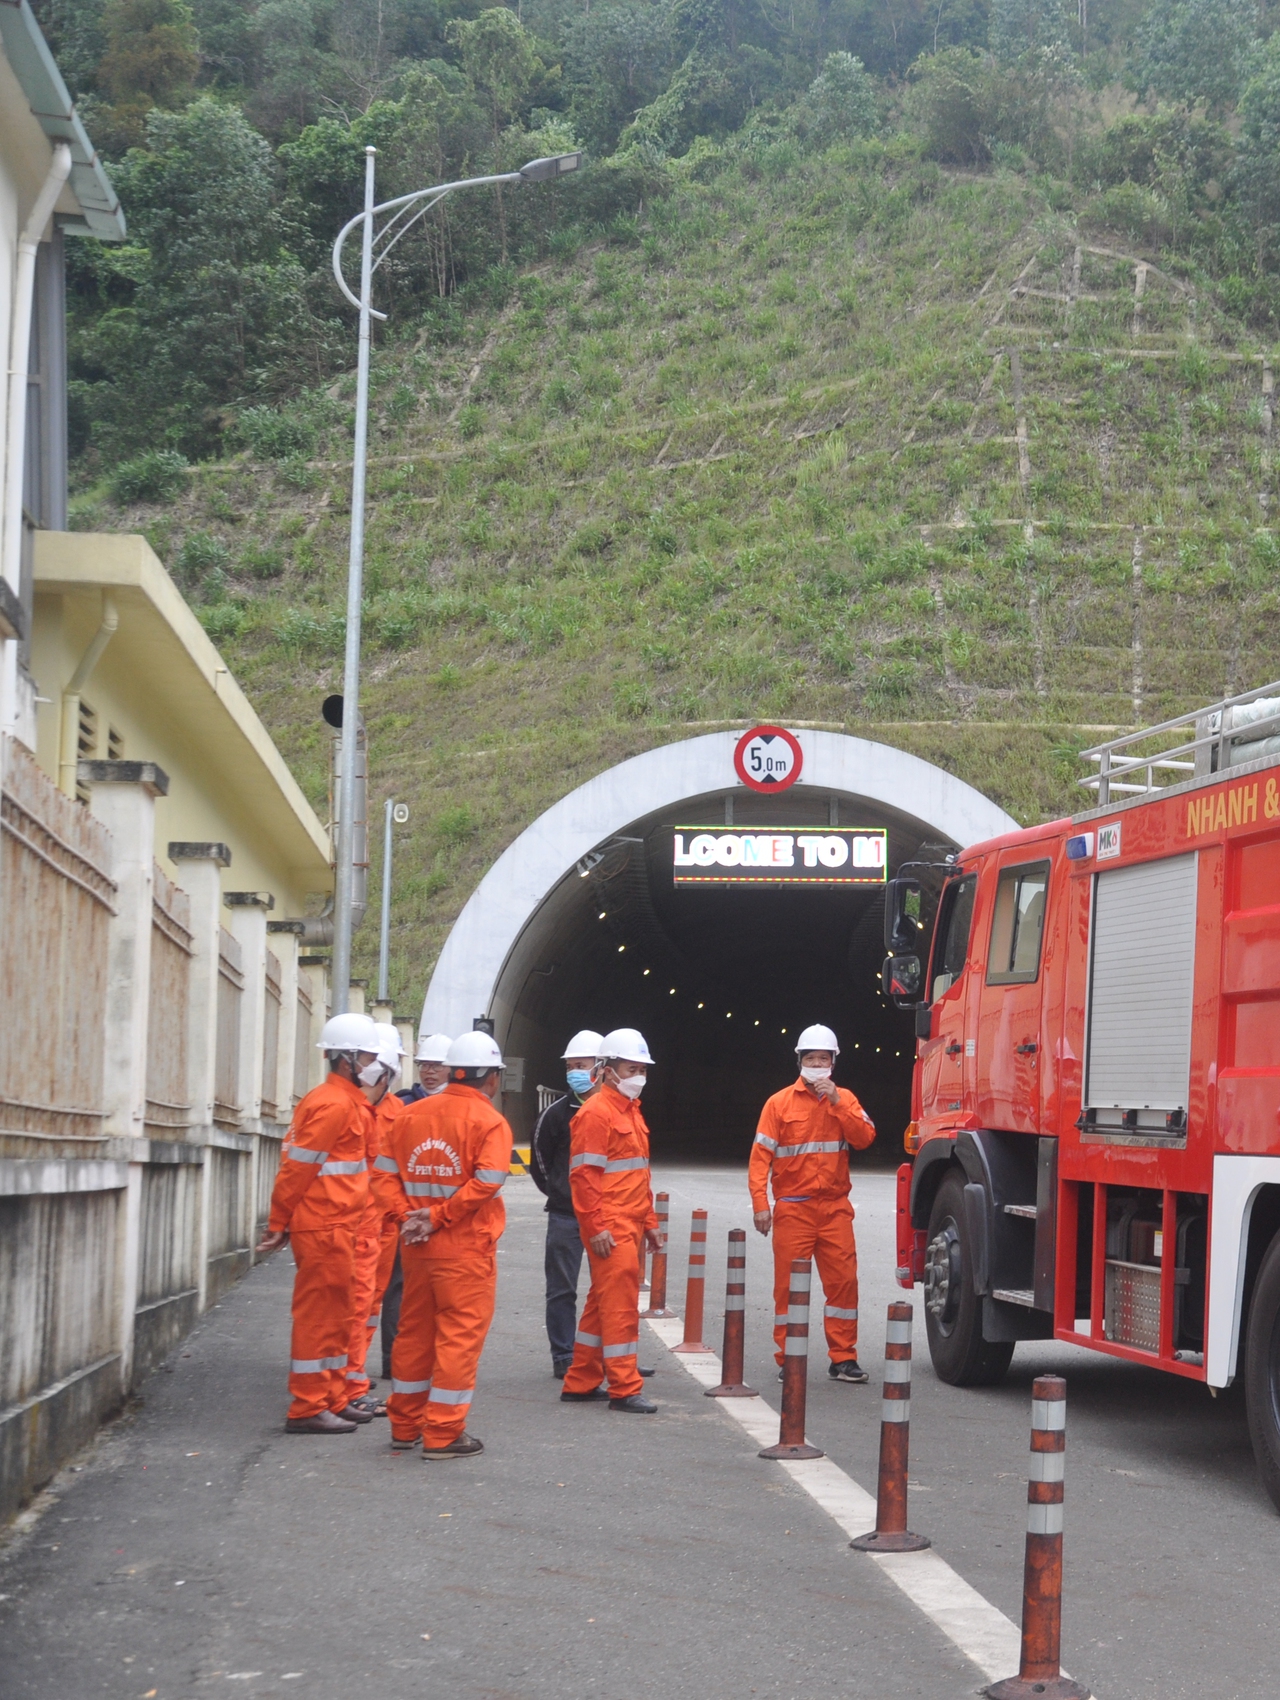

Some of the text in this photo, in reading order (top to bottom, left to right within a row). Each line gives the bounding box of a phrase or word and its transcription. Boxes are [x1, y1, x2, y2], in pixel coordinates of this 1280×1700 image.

[1186, 783, 1258, 838] NHANH
[1264, 777, 1280, 819] &
[797, 835, 849, 868] TO
[1099, 830, 1112, 851] MK
[433, 1164, 454, 1177] YÊN
